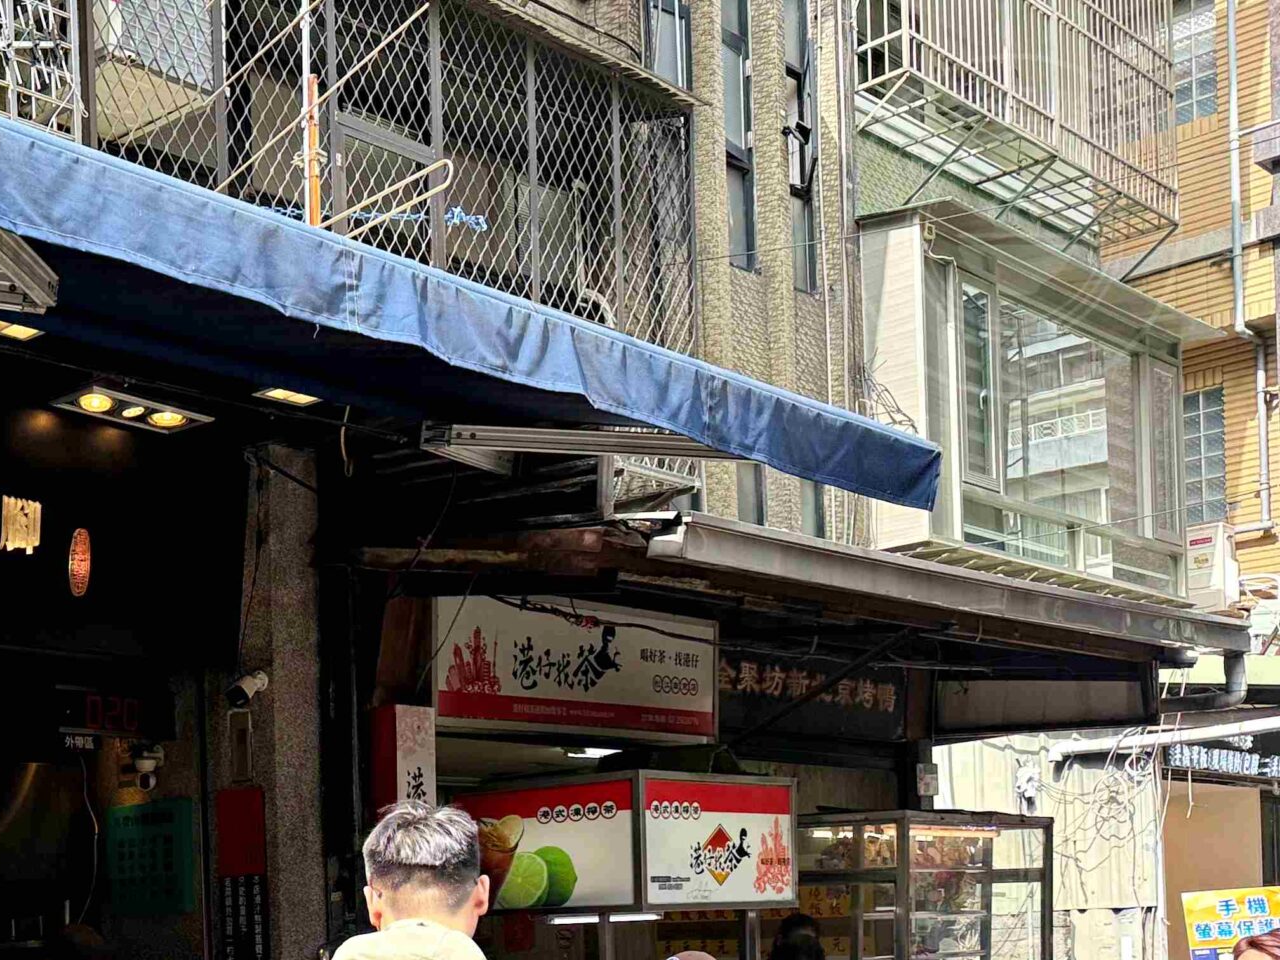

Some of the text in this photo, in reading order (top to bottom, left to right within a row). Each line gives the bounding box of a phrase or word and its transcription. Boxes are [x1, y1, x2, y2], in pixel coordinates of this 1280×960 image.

[512, 636, 606, 692] 港仔找茶
[690, 842, 743, 874] 港仔找茶
[1218, 897, 1268, 917] 手機
[1195, 918, 1280, 939] 螢幕保護
